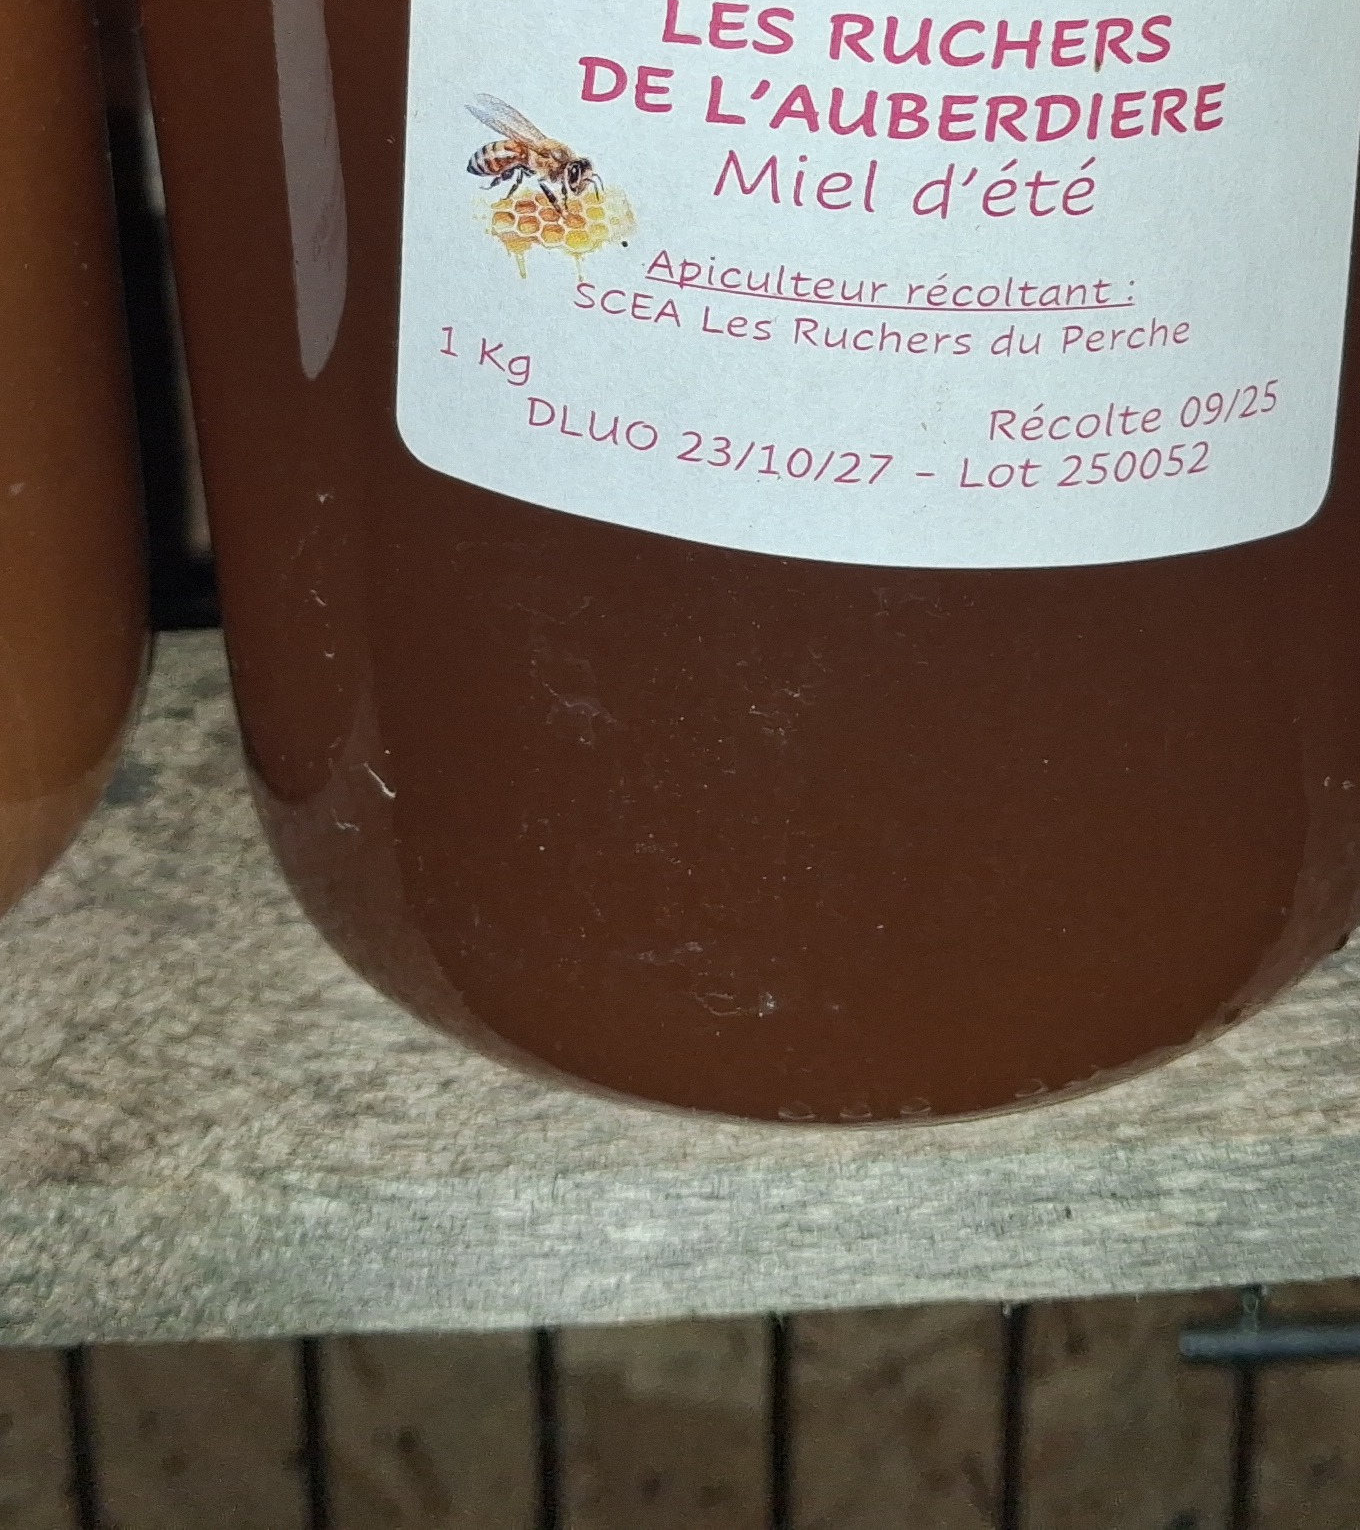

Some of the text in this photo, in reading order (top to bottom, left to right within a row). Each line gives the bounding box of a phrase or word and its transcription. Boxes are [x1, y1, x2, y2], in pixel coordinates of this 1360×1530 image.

[829, 11, 1171, 70] RUCHERS
[578, 55, 675, 114] DE
[712, 149, 878, 215] Miel
[644, 248, 888, 307] Apiculteur
[908, 274, 1110, 310] récoltant
[574, 282, 1191, 356] SCEA Les Ruchers du Perche
[439, 326, 532, 386] 1 Kg
[988, 379, 1280, 443] Récolte 09/25
[527, 396, 659, 451] DLUO
[677, 430, 894, 483] 23/10/27
[959, 455, 1040, 490] Lot
[1057, 442, 1211, 487] 250052
